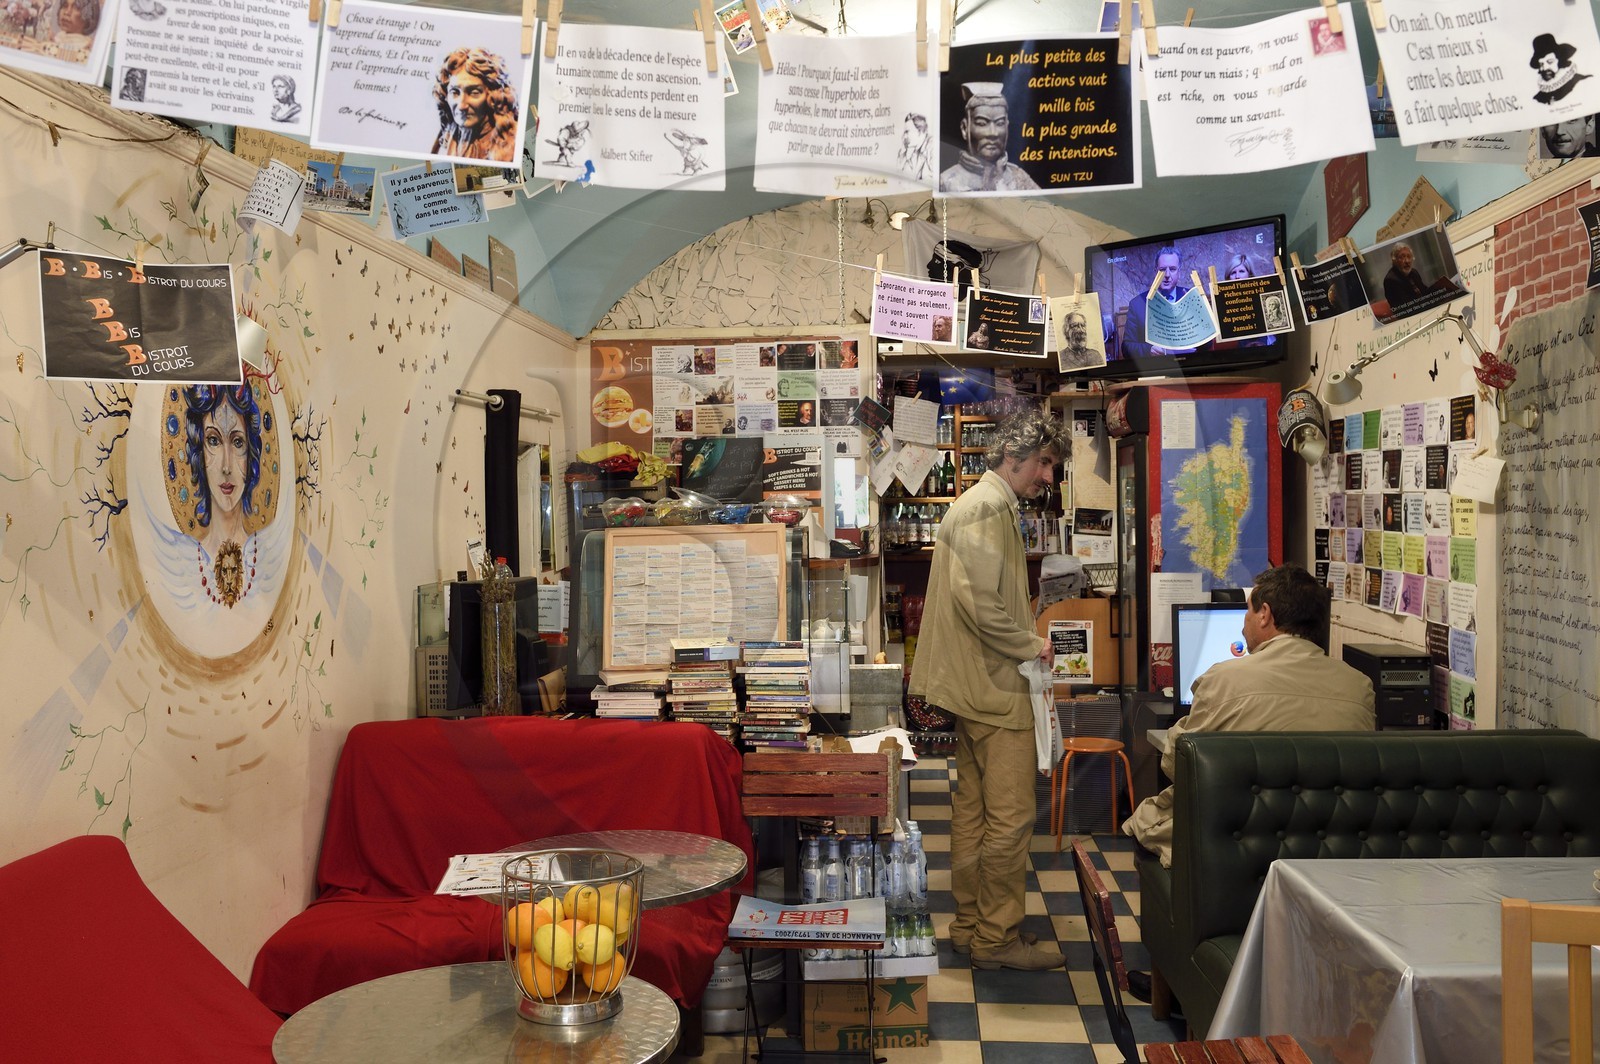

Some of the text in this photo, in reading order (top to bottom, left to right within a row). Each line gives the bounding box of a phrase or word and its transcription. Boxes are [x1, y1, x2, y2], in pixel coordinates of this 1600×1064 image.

[346, 13, 434, 31] Chose étrange ! On
[1389, 15, 1408, 33] On
[1434, 12, 1454, 30] On
[1456, 6, 1497, 27] meurt.
[336, 28, 441, 47] apprend la tempérance
[1437, 37, 1474, 58] mieux
[1476, 32, 1488, 54] si
[331, 46, 349, 56] aux
[351, 45, 382, 58] chiens,
[386, 50, 398, 59] Et
[401, 50, 419, 61] l'on
[1158, 43, 1184, 58] uand
[1187, 47, 1198, 55] on
[1201, 47, 1213, 55] est
[1216, 46, 1252, 60] pauvre,
[1273, 33, 1298, 46] vous
[566, 50, 576, 58] en
[588, 48, 595, 59] de
[595, 48, 602, 59] la
[603, 48, 652, 63] décadence
[654, 52, 665, 64] de
[667, 52, 701, 69] l'espèce
[986, 48, 1105, 69] La plus petite des
[330, 60, 429, 80] peut l'apprendre aux
[556, 64, 701, 85] humaine comme de son ascension.
[776, 62, 888, 84] Hélas ! Pourquoi faut-il entendre
[1408, 65, 1503, 91] entre les deux on
[354, 79, 397, 93] hommes !
[1028, 73, 1107, 88] actions vaut
[789, 86, 879, 103] sans cesse l'hyperbole des
[1158, 92, 1171, 101] est
[1181, 89, 1204, 103] riche,
[1213, 92, 1225, 102] on
[1234, 91, 1257, 100] vous
[559, 102, 591, 114] premier
[605, 104, 612, 116] le
[615, 108, 636, 117] sens
[639, 106, 651, 118] de
[654, 107, 661, 118] la
[664, 111, 696, 120] mesure
[1039, 97, 1095, 113] mille fois
[1405, 110, 1413, 125] a
[1414, 100, 1436, 123] fait
[1438, 97, 1483, 126] quelque
[1485, 92, 1523, 114] chose.
[1196, 114, 1227, 124] comme
[1246, 109, 1284, 122] savant.
[1022, 119, 1117, 141] la plus grande
[629, 150, 653, 161] Stifter
[1020, 144, 1117, 161] des intentions.
[417, 179, 449, 191] parvenus
[1051, 172, 1093, 182] SUN TZU
[423, 189, 452, 199] connerie
[424, 199, 447, 208] comme
[415, 211, 431, 219] dans
[44, 258, 66, 275] B
[180, 279, 193, 288] DU
[196, 279, 227, 287] COURS
[880, 281, 906, 292] Ignorance
[918, 289, 946, 297] arrogance
[86, 298, 114, 319] B
[879, 306, 887, 314] ils
[887, 295, 904, 304] riment
[920, 301, 950, 310] seulement,
[131, 357, 194, 376] DU COURS
